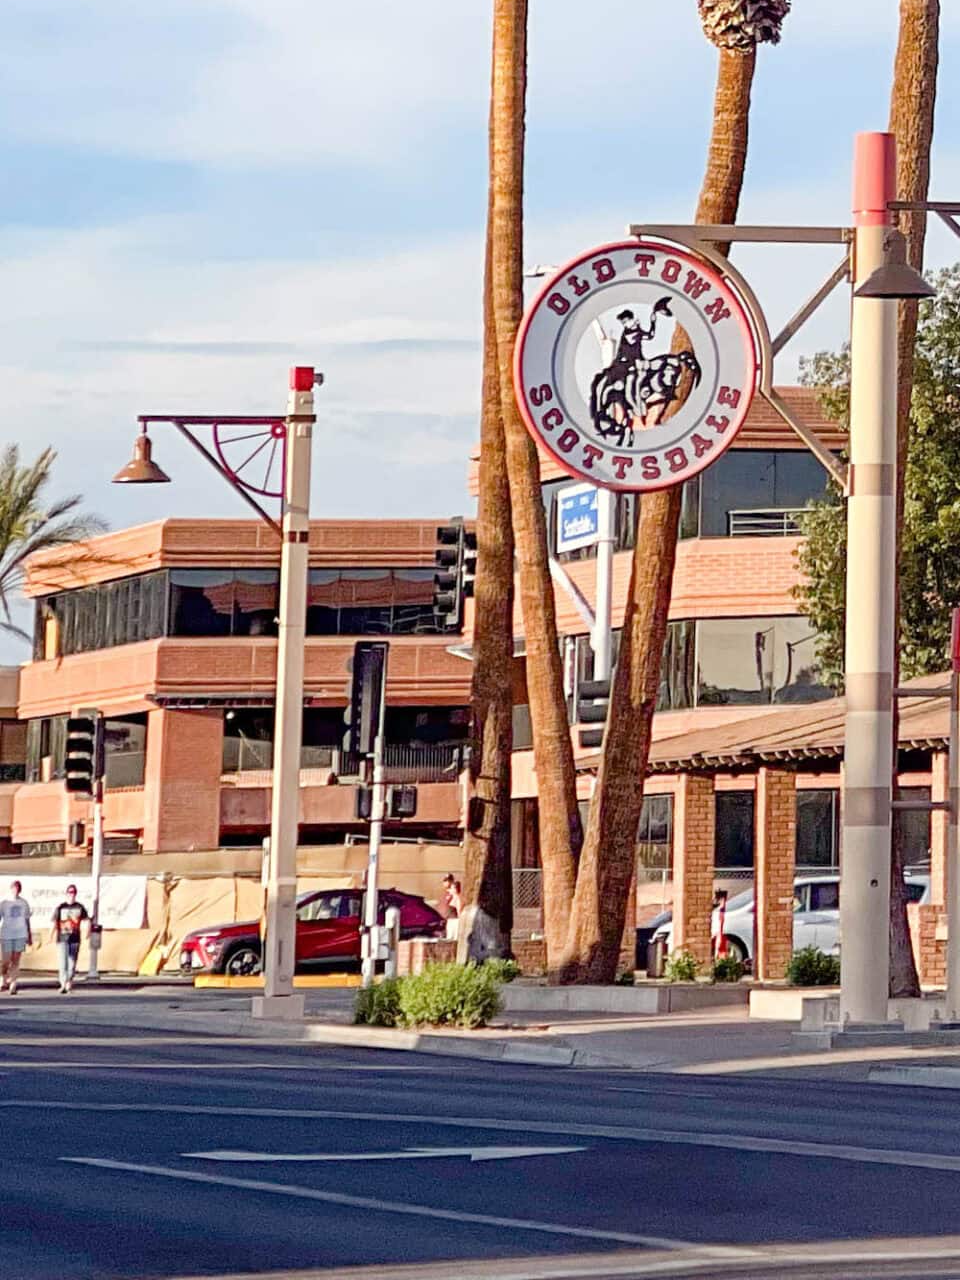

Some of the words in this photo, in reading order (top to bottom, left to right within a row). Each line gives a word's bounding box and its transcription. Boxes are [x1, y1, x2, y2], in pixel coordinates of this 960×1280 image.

[547, 258, 616, 316] OLD
[635, 253, 731, 324] TOWN
[529, 384, 741, 479] SCOTTSDALE
